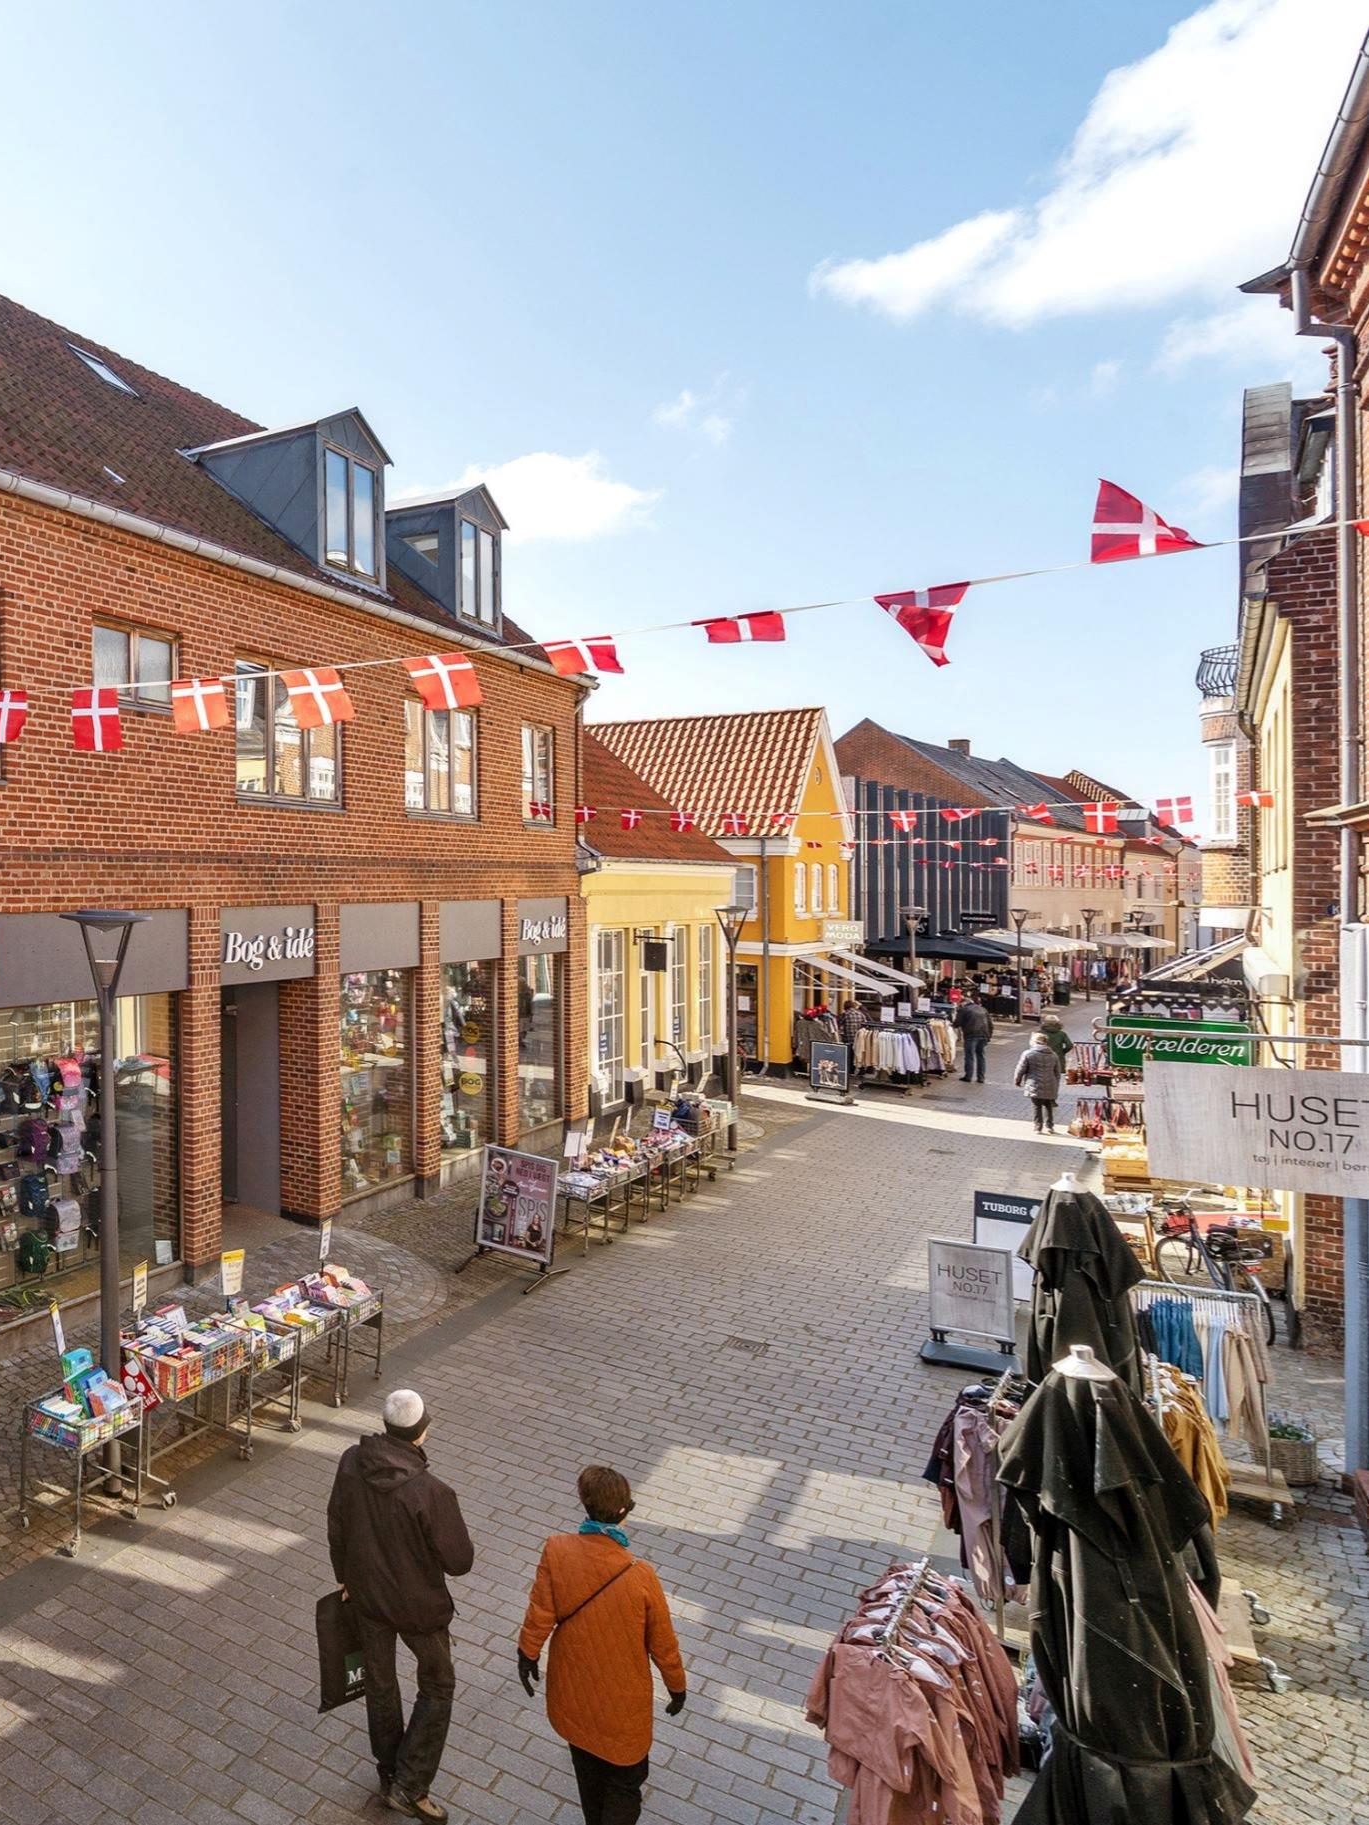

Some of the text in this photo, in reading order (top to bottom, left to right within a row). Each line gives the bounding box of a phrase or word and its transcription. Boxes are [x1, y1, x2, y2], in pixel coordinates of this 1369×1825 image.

[520, 915, 566, 946] Bog & idé
[824, 931, 861, 941] MODA
[826, 922, 859, 932] VERO
[223, 926, 315, 971] Bog & idé
[1269, 1128, 1355, 1154] NO.17
[1281, 1155, 1332, 1169] interiør
[518, 1196, 549, 1222] SPIS
[982, 1201, 1028, 1216] TUBORG
[937, 1263, 1002, 1285] HUSET
[952, 1281, 988, 1295] NO.17
